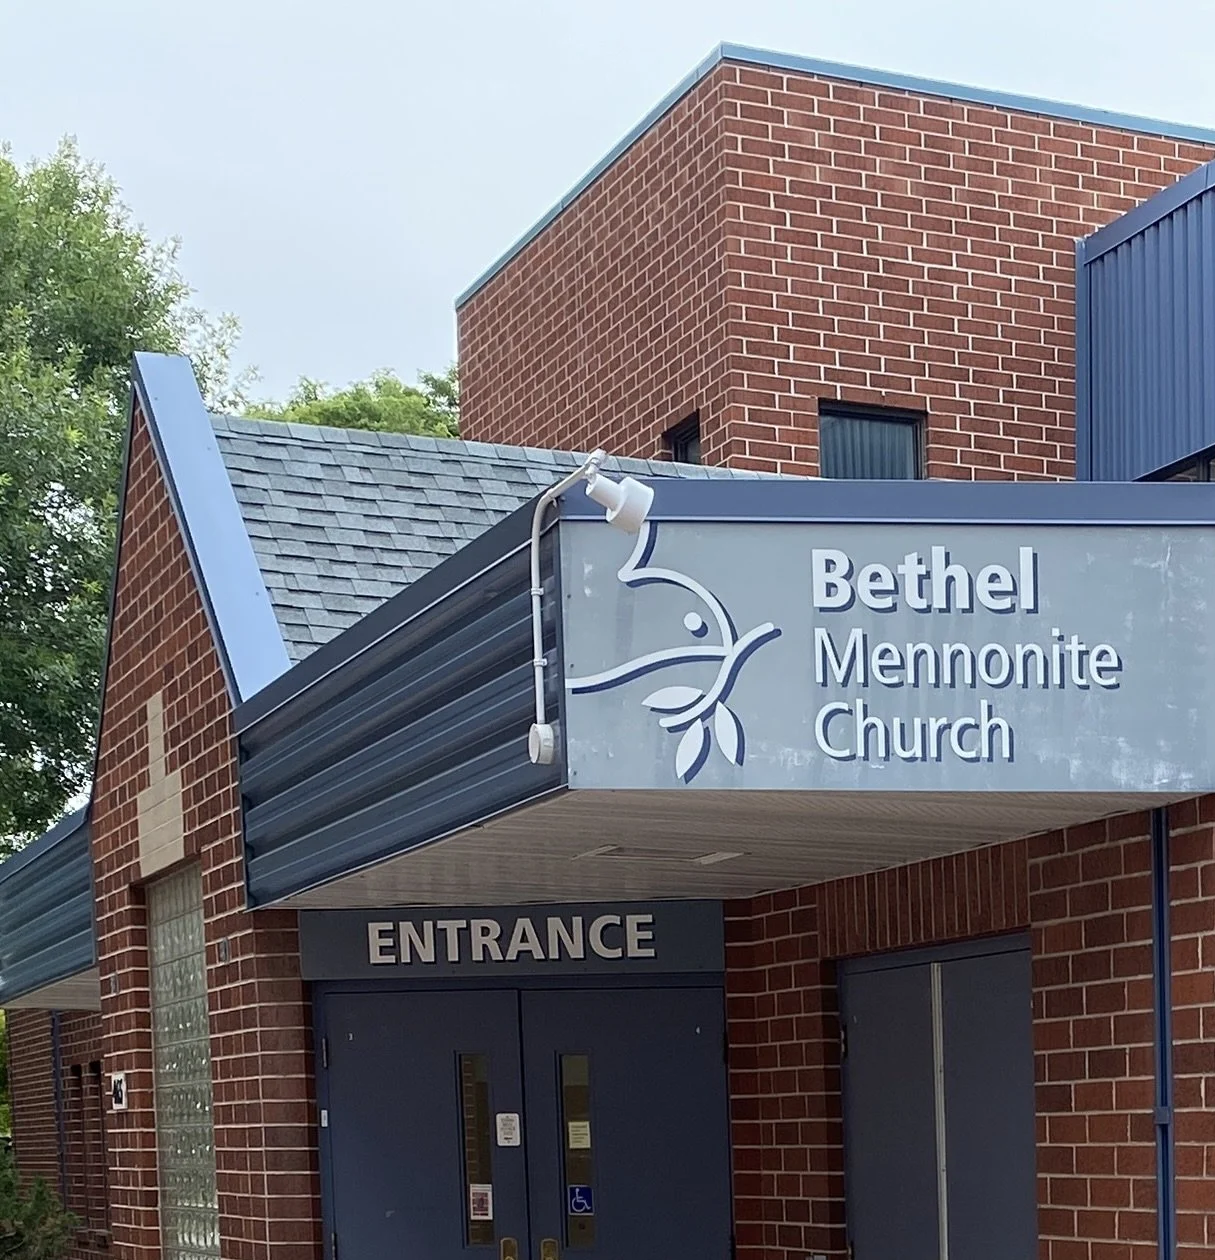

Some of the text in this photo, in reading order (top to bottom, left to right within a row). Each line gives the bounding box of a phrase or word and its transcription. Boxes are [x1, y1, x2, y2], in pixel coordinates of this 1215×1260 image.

[812, 546, 1035, 611] Bethel
[815, 628, 1118, 687] Mennonite
[815, 699, 1011, 759] Church
[367, 914, 656, 964] ENTRANCE
